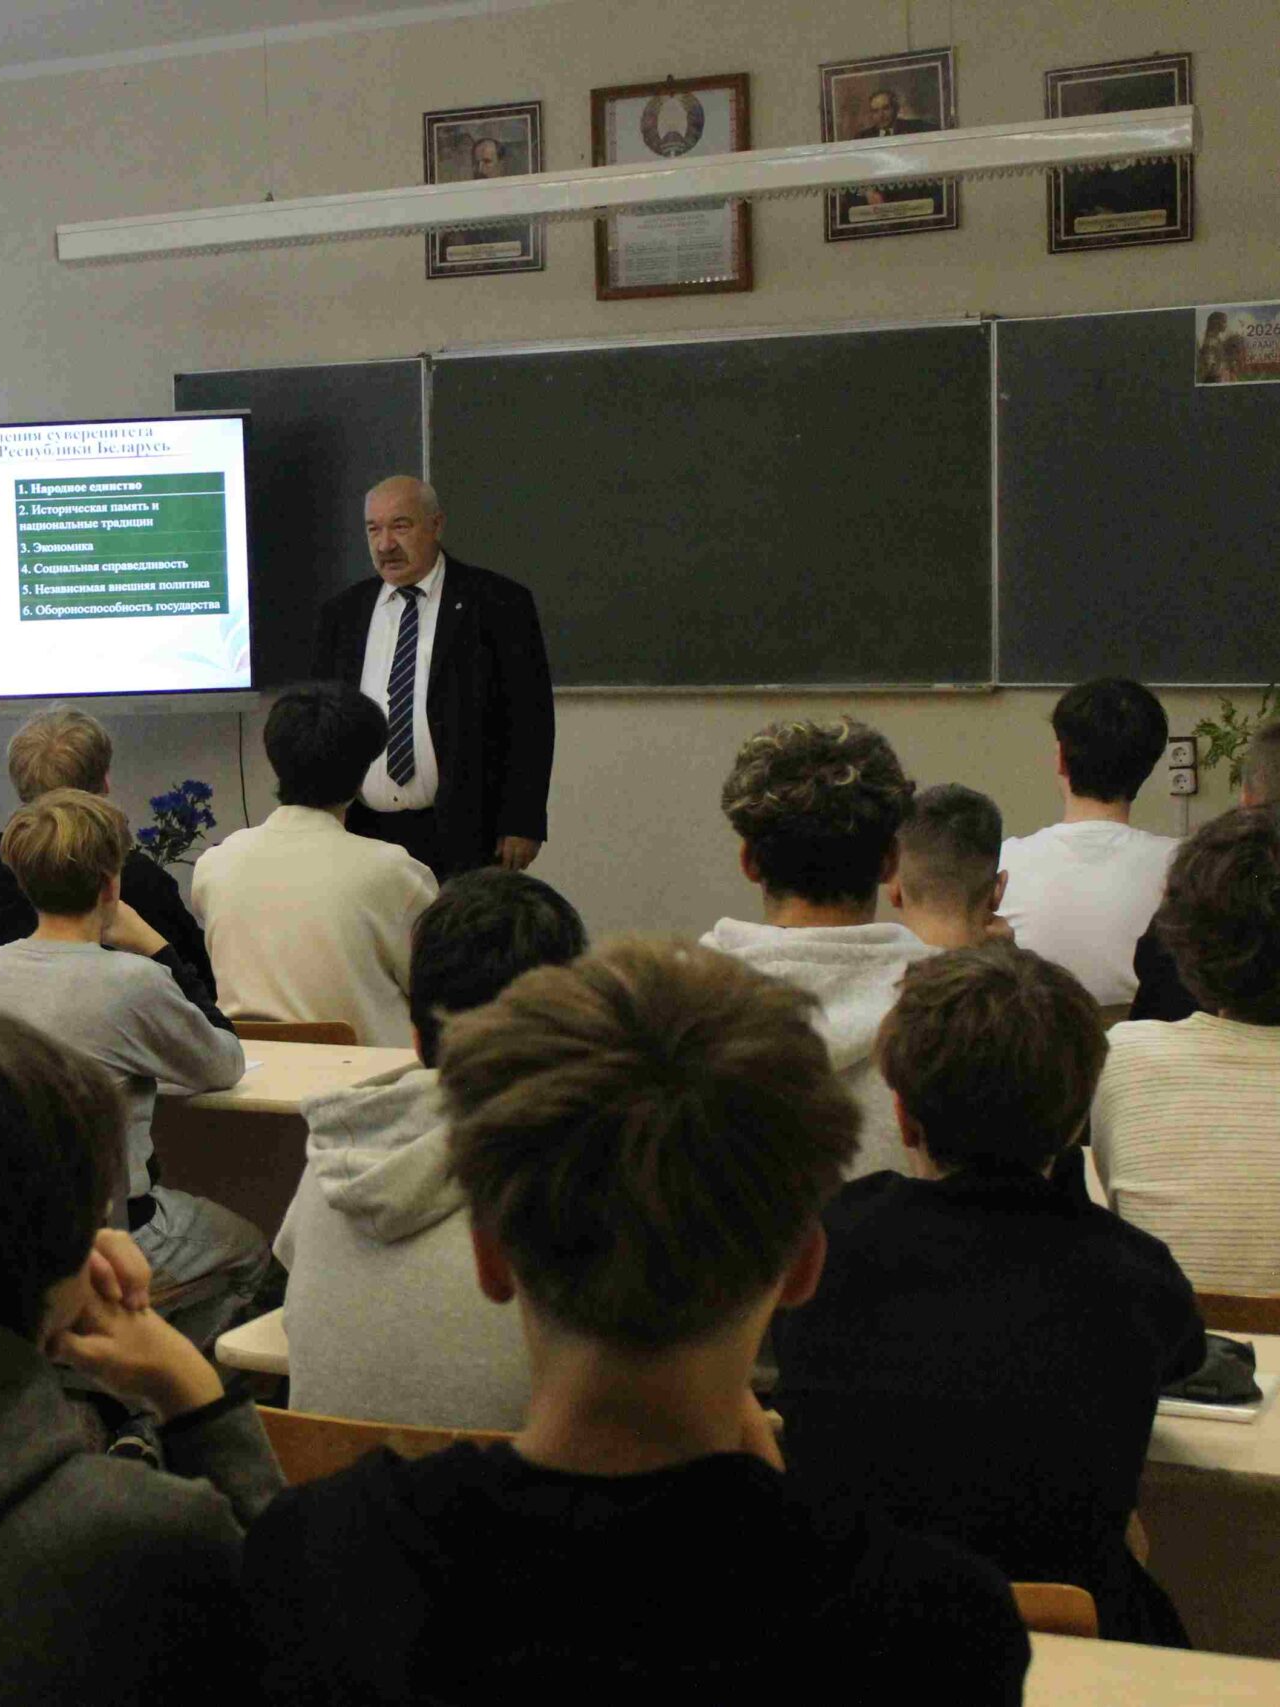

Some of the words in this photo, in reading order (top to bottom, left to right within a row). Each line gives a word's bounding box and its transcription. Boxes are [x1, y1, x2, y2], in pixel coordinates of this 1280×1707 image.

[47, 426, 153, 443] суверенитета
[0, 443, 91, 460] Республики
[98, 441, 171, 457] Беларусь
[18, 484, 28, 494] 1.
[31, 483, 87, 496] Народное
[89, 481, 142, 493] единство
[18, 505, 29, 516] 2.
[31, 504, 108, 517] Историческая
[110, 502, 150, 512] память
[152, 502, 159, 511] и
[19, 520, 99, 531] национальные
[101, 518, 154, 531] традиции
[20, 543, 31, 553] 3.
[32, 542, 94, 553] Экономика
[21, 564, 31, 574] 4.
[33, 562, 99, 574] Социальная
[101, 560, 189, 574] справедливость
[21, 584, 32, 595] 5.
[35, 583, 106, 595] Независимая
[108, 581, 156, 593] внешняя
[158, 579, 210, 591] политика
[22, 605, 33, 616] 6.
[35, 601, 153, 618] Обороноспособность
[155, 600, 220, 613] государства
